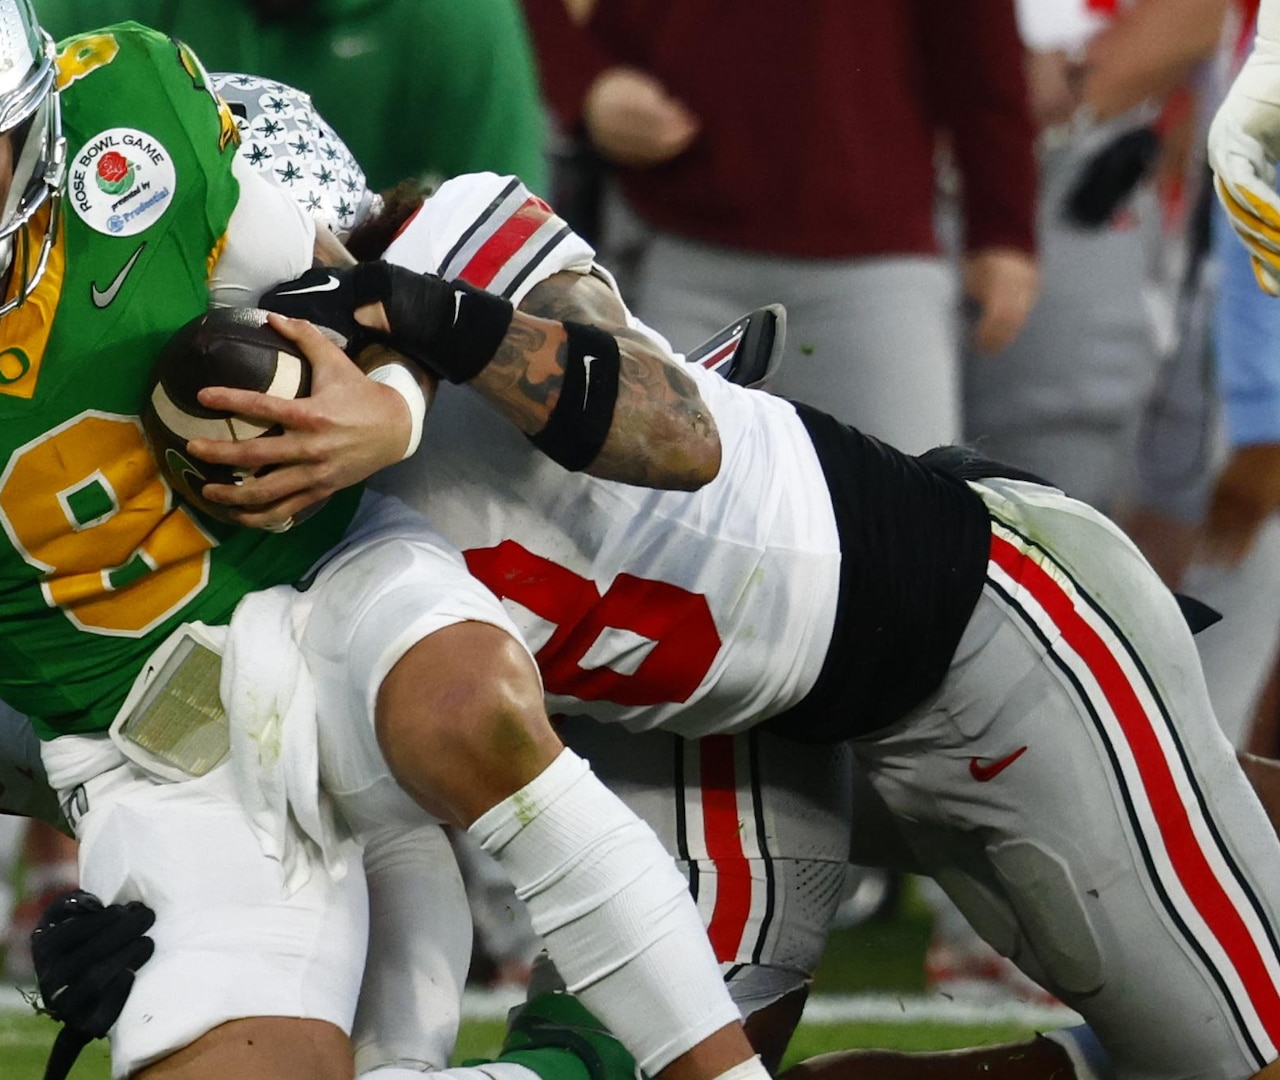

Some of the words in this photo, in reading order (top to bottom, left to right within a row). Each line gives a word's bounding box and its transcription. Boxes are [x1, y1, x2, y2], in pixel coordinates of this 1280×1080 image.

[79, 135, 120, 168] BOWL
[122, 134, 165, 166] GAME
[73, 169, 93, 213] ROSE
